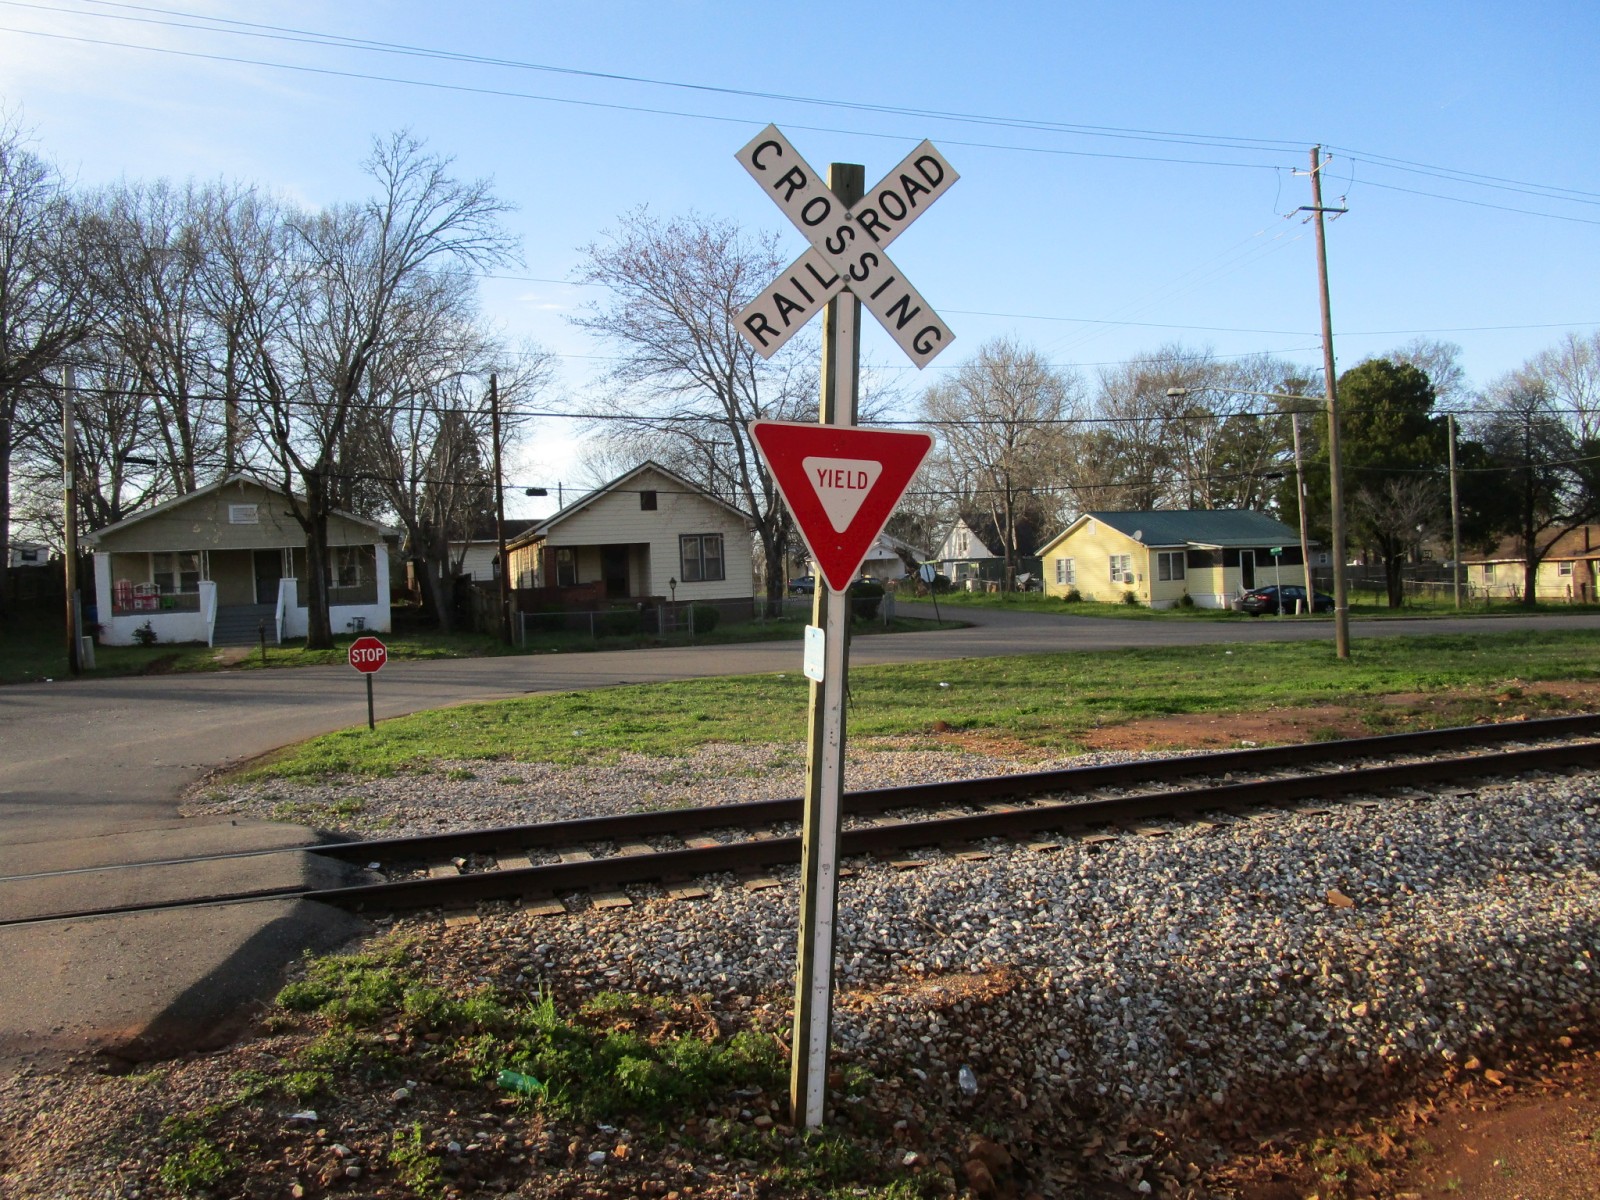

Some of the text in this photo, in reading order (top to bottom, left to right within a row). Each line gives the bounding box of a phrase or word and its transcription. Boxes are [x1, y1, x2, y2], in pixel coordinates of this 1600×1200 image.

[743, 155, 944, 348] RAIL ROAD
[751, 140, 942, 355] CROSSING
[817, 468, 868, 490] YIELD
[352, 648, 384, 663] STOP
